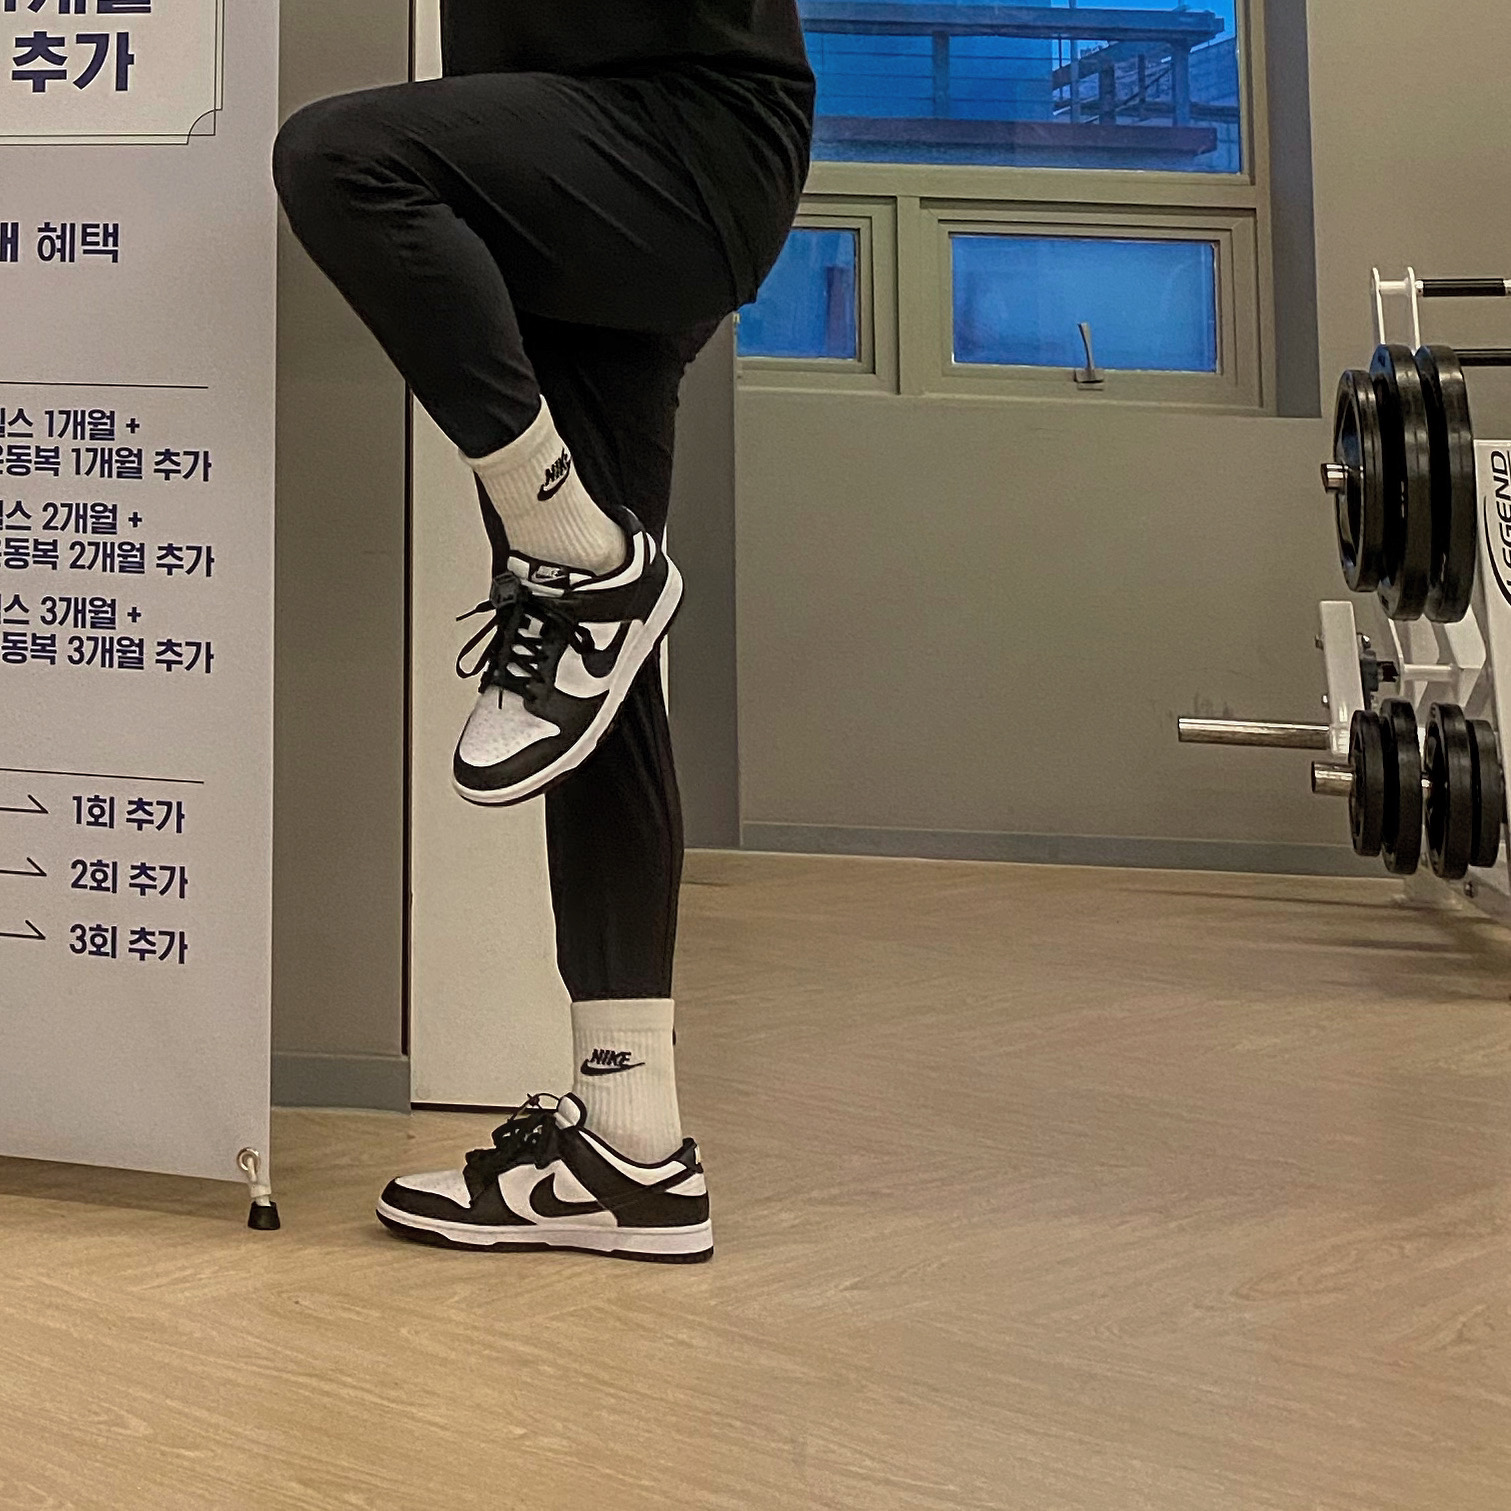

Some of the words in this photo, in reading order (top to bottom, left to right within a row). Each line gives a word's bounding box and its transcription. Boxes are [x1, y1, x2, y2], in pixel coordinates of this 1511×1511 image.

[12, 31, 134, 92] 추가
[38, 222, 118, 263] 혜택
[45, 410, 115, 441] 1개월
[72, 447, 142, 479] 1개월
[154, 449, 212, 482] 추가
[42, 502, 117, 535] 2개월
[1491, 450, 1511, 587] EGEND
[69, 541, 145, 574] 2개월
[156, 543, 214, 577] 추가
[40, 596, 116, 630] 3개월
[68, 636, 144, 670] 3개월
[155, 639, 214, 673] 추가
[73, 795, 114, 829] 1회
[126, 798, 185, 833] 추가
[71, 859, 117, 893] 2회
[129, 862, 188, 899] 추가
[70, 924, 117, 959] 3회
[128, 927, 188, 964] 추가
[590, 1048, 632, 1067] NIKE
